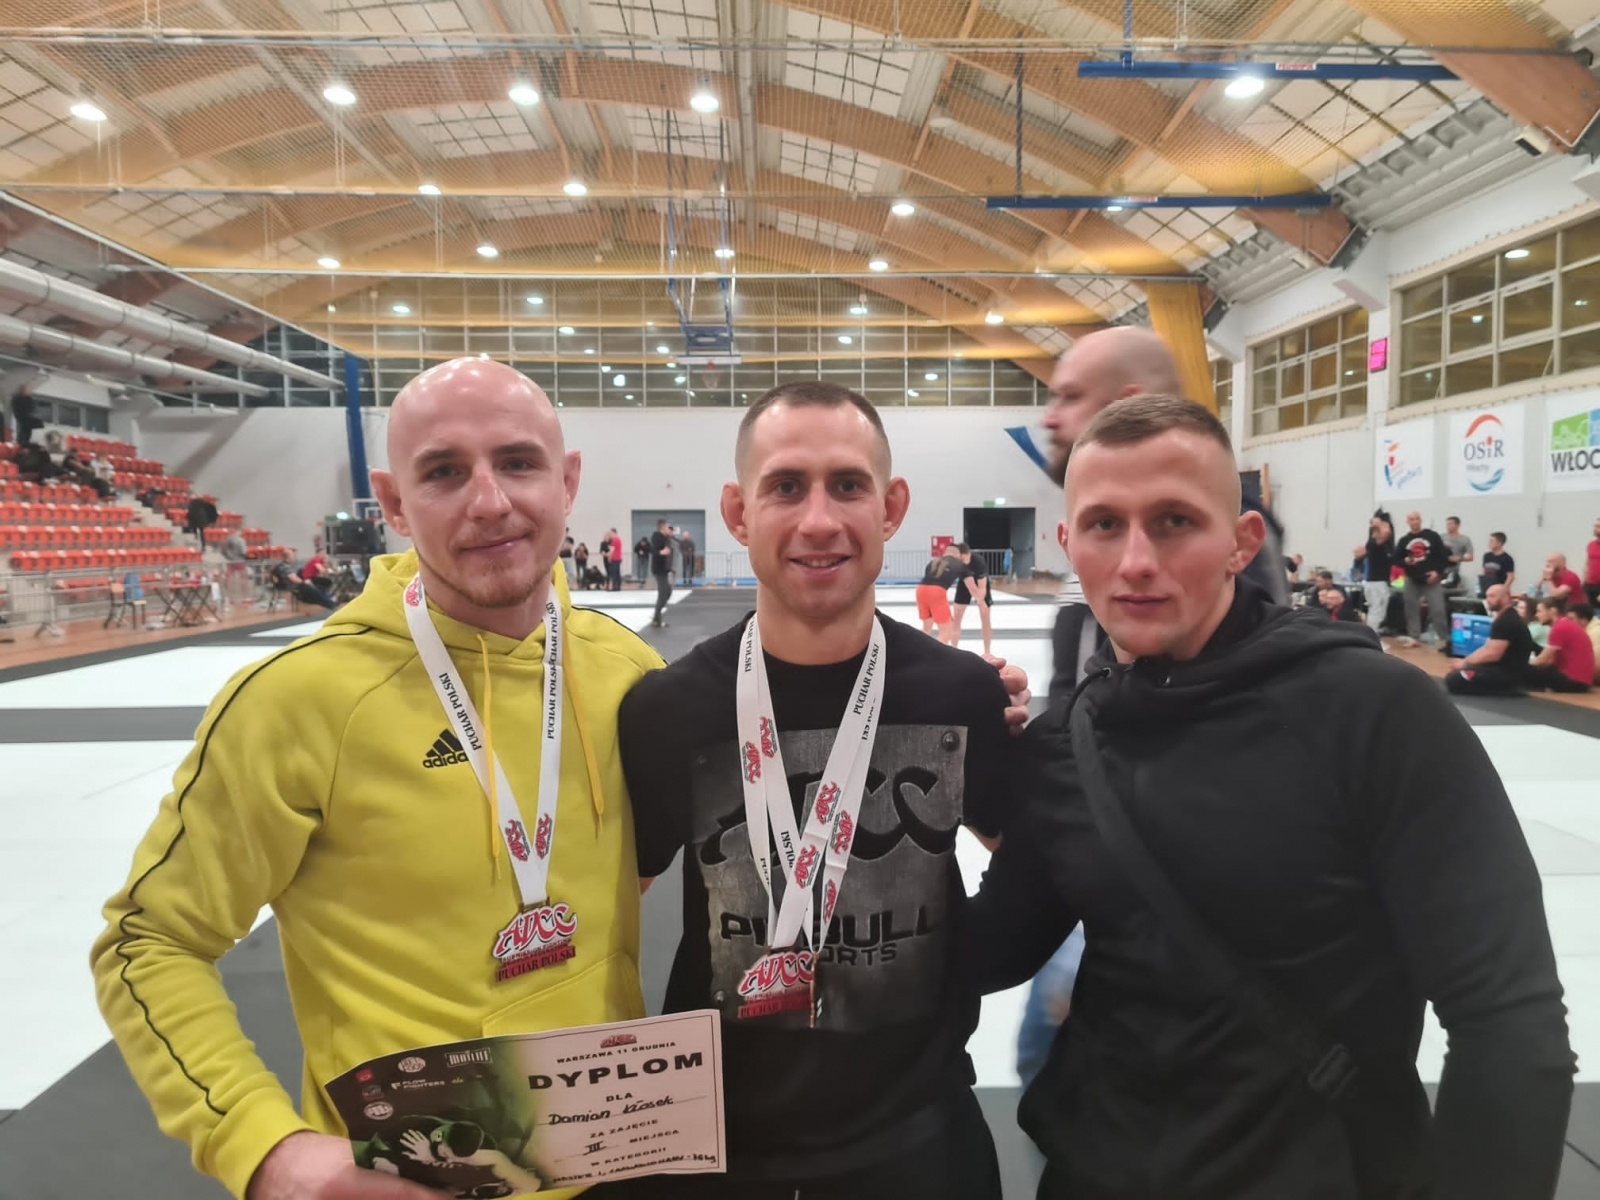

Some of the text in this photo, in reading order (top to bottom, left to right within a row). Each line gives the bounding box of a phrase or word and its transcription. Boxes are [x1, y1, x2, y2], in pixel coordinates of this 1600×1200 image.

[1464, 436, 1504, 461] OSiR
[853, 677, 871, 715] PUCHAR
[866, 643, 880, 677] POLSKI
[438, 672, 482, 751] PUCHAR POLSKI
[547, 699, 556, 739] PUCHAR
[422, 751, 469, 768] adida
[493, 905, 577, 958] ADCC
[738, 951, 815, 997] ADCC
[557, 1051, 613, 1064] WARSZAWA
[631, 1041, 676, 1053] GRUDNIA
[528, 1052, 703, 1090] DYPLOM
[606, 1092, 633, 1102] DLA
[548, 1110, 611, 1125] Damian
[590, 1119, 658, 1139] ZA ZAJĘCIE
[629, 1129, 680, 1143] MIEJSCA
[604, 1147, 667, 1164] KATEGORII
